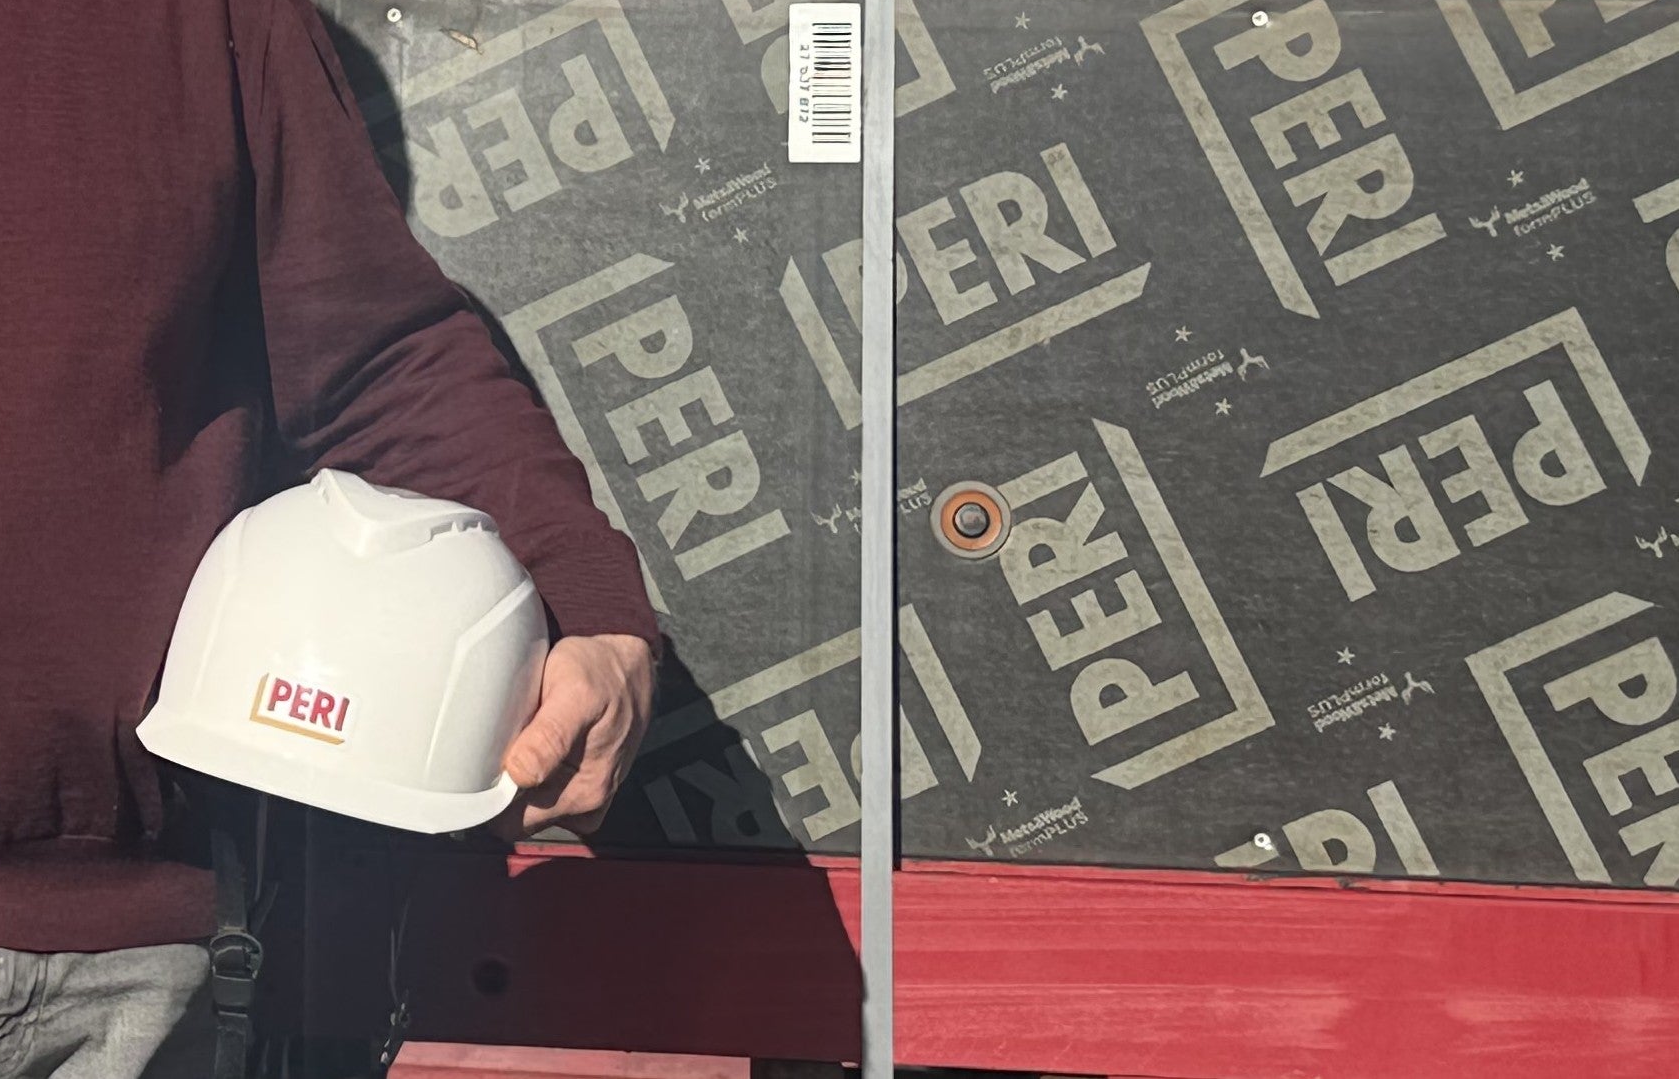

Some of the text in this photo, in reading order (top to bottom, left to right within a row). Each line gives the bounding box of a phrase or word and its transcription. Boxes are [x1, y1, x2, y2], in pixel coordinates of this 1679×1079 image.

[380, 53, 635, 238] PER
[571, 294, 792, 582] PERI
[1296, 379, 1608, 602] PERI
[266, 677, 351, 732] PERI
[998, 451, 1199, 746] PERI
